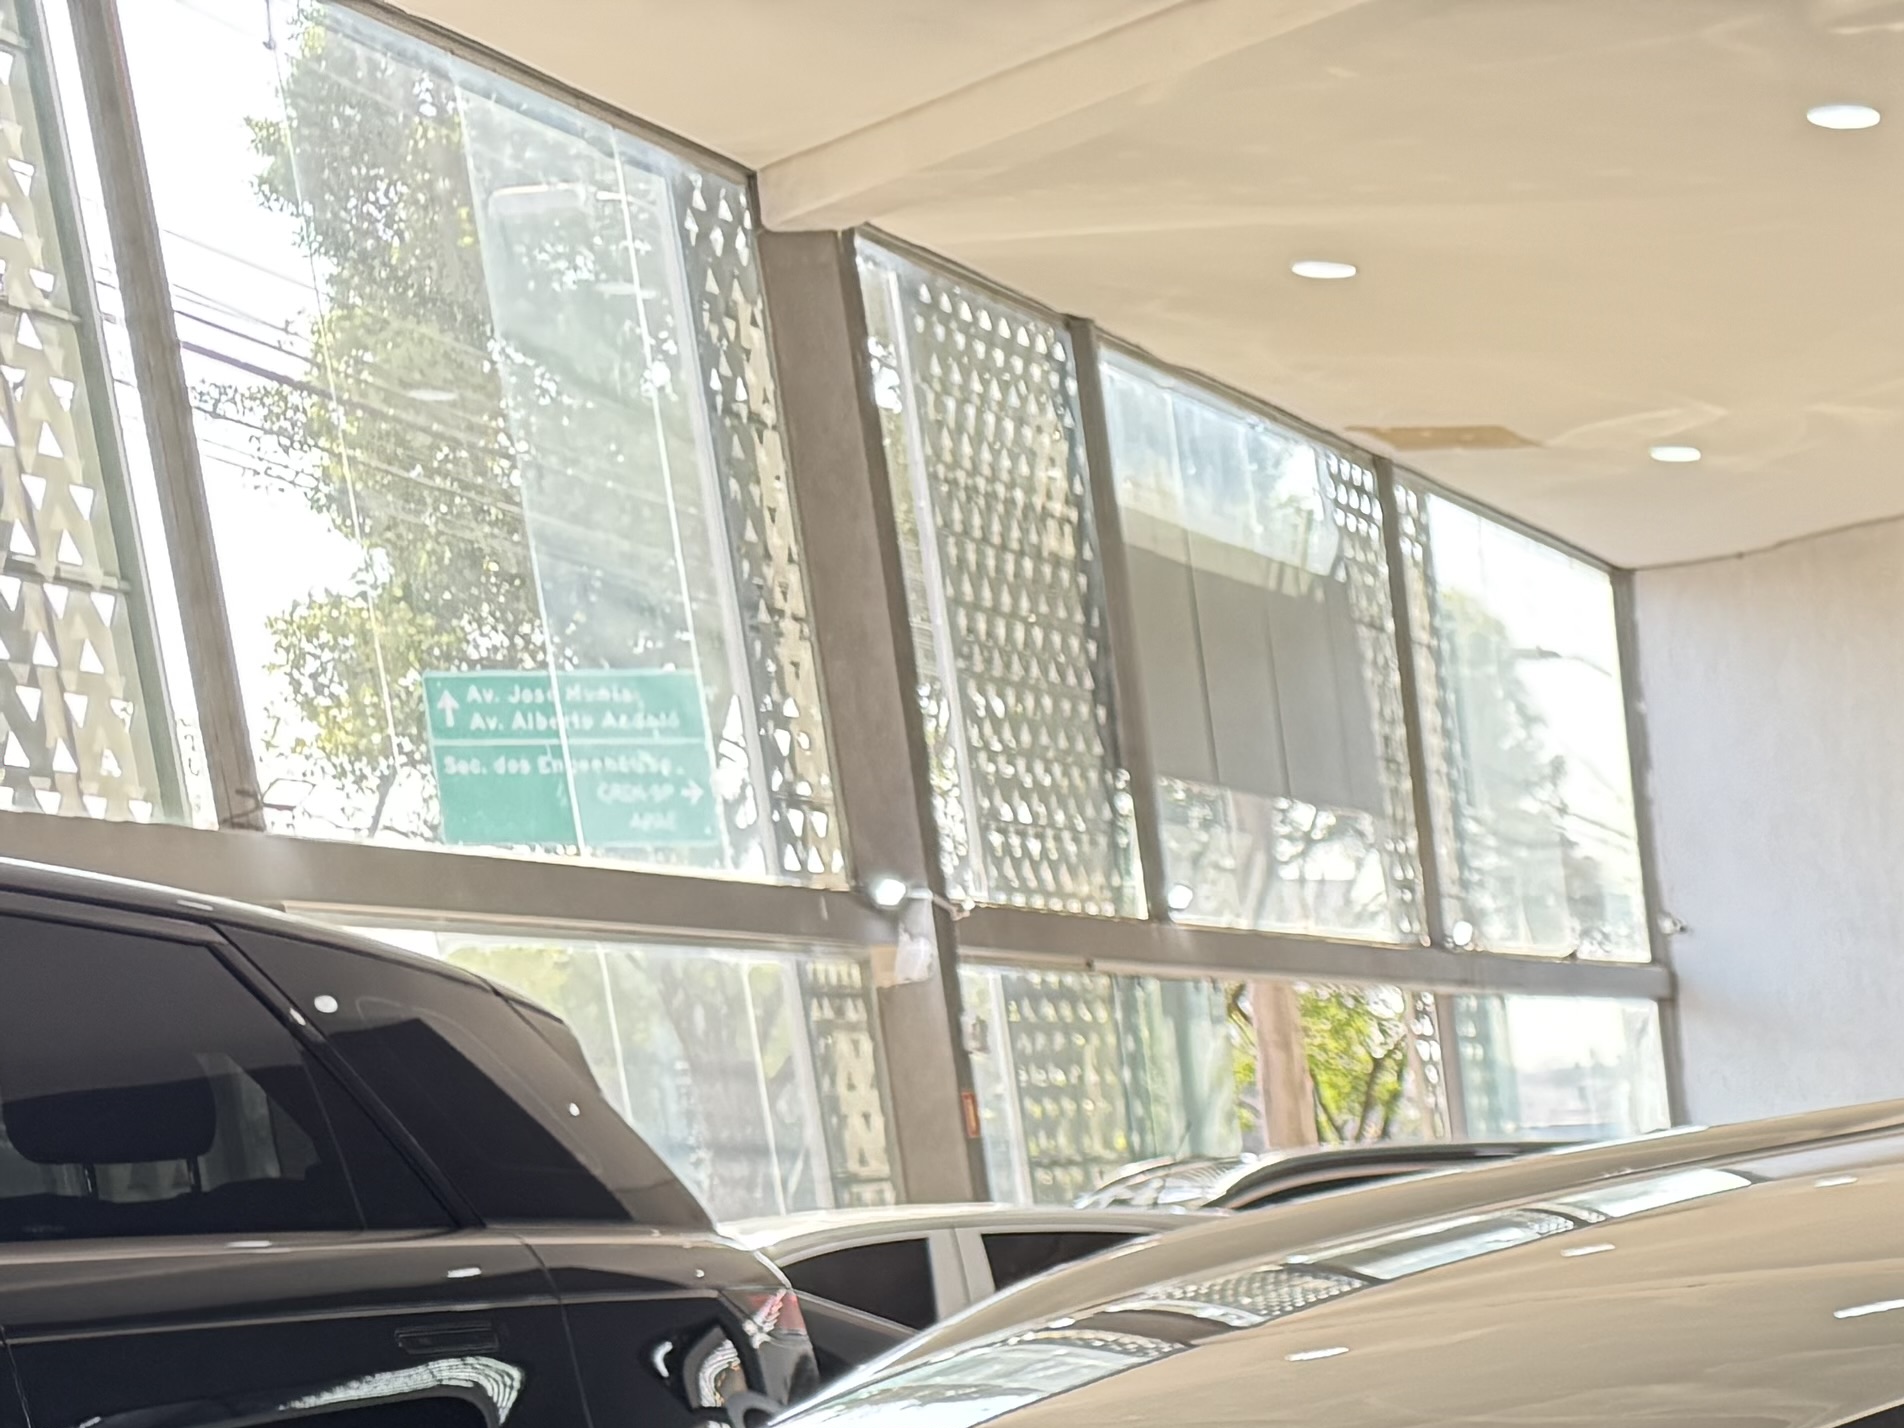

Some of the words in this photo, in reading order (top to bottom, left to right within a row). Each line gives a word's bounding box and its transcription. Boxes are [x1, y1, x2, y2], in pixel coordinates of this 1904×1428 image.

[466, 684, 500, 703] Av.
[470, 712, 504, 730] Av.
[511, 711, 593, 730] Albeto
